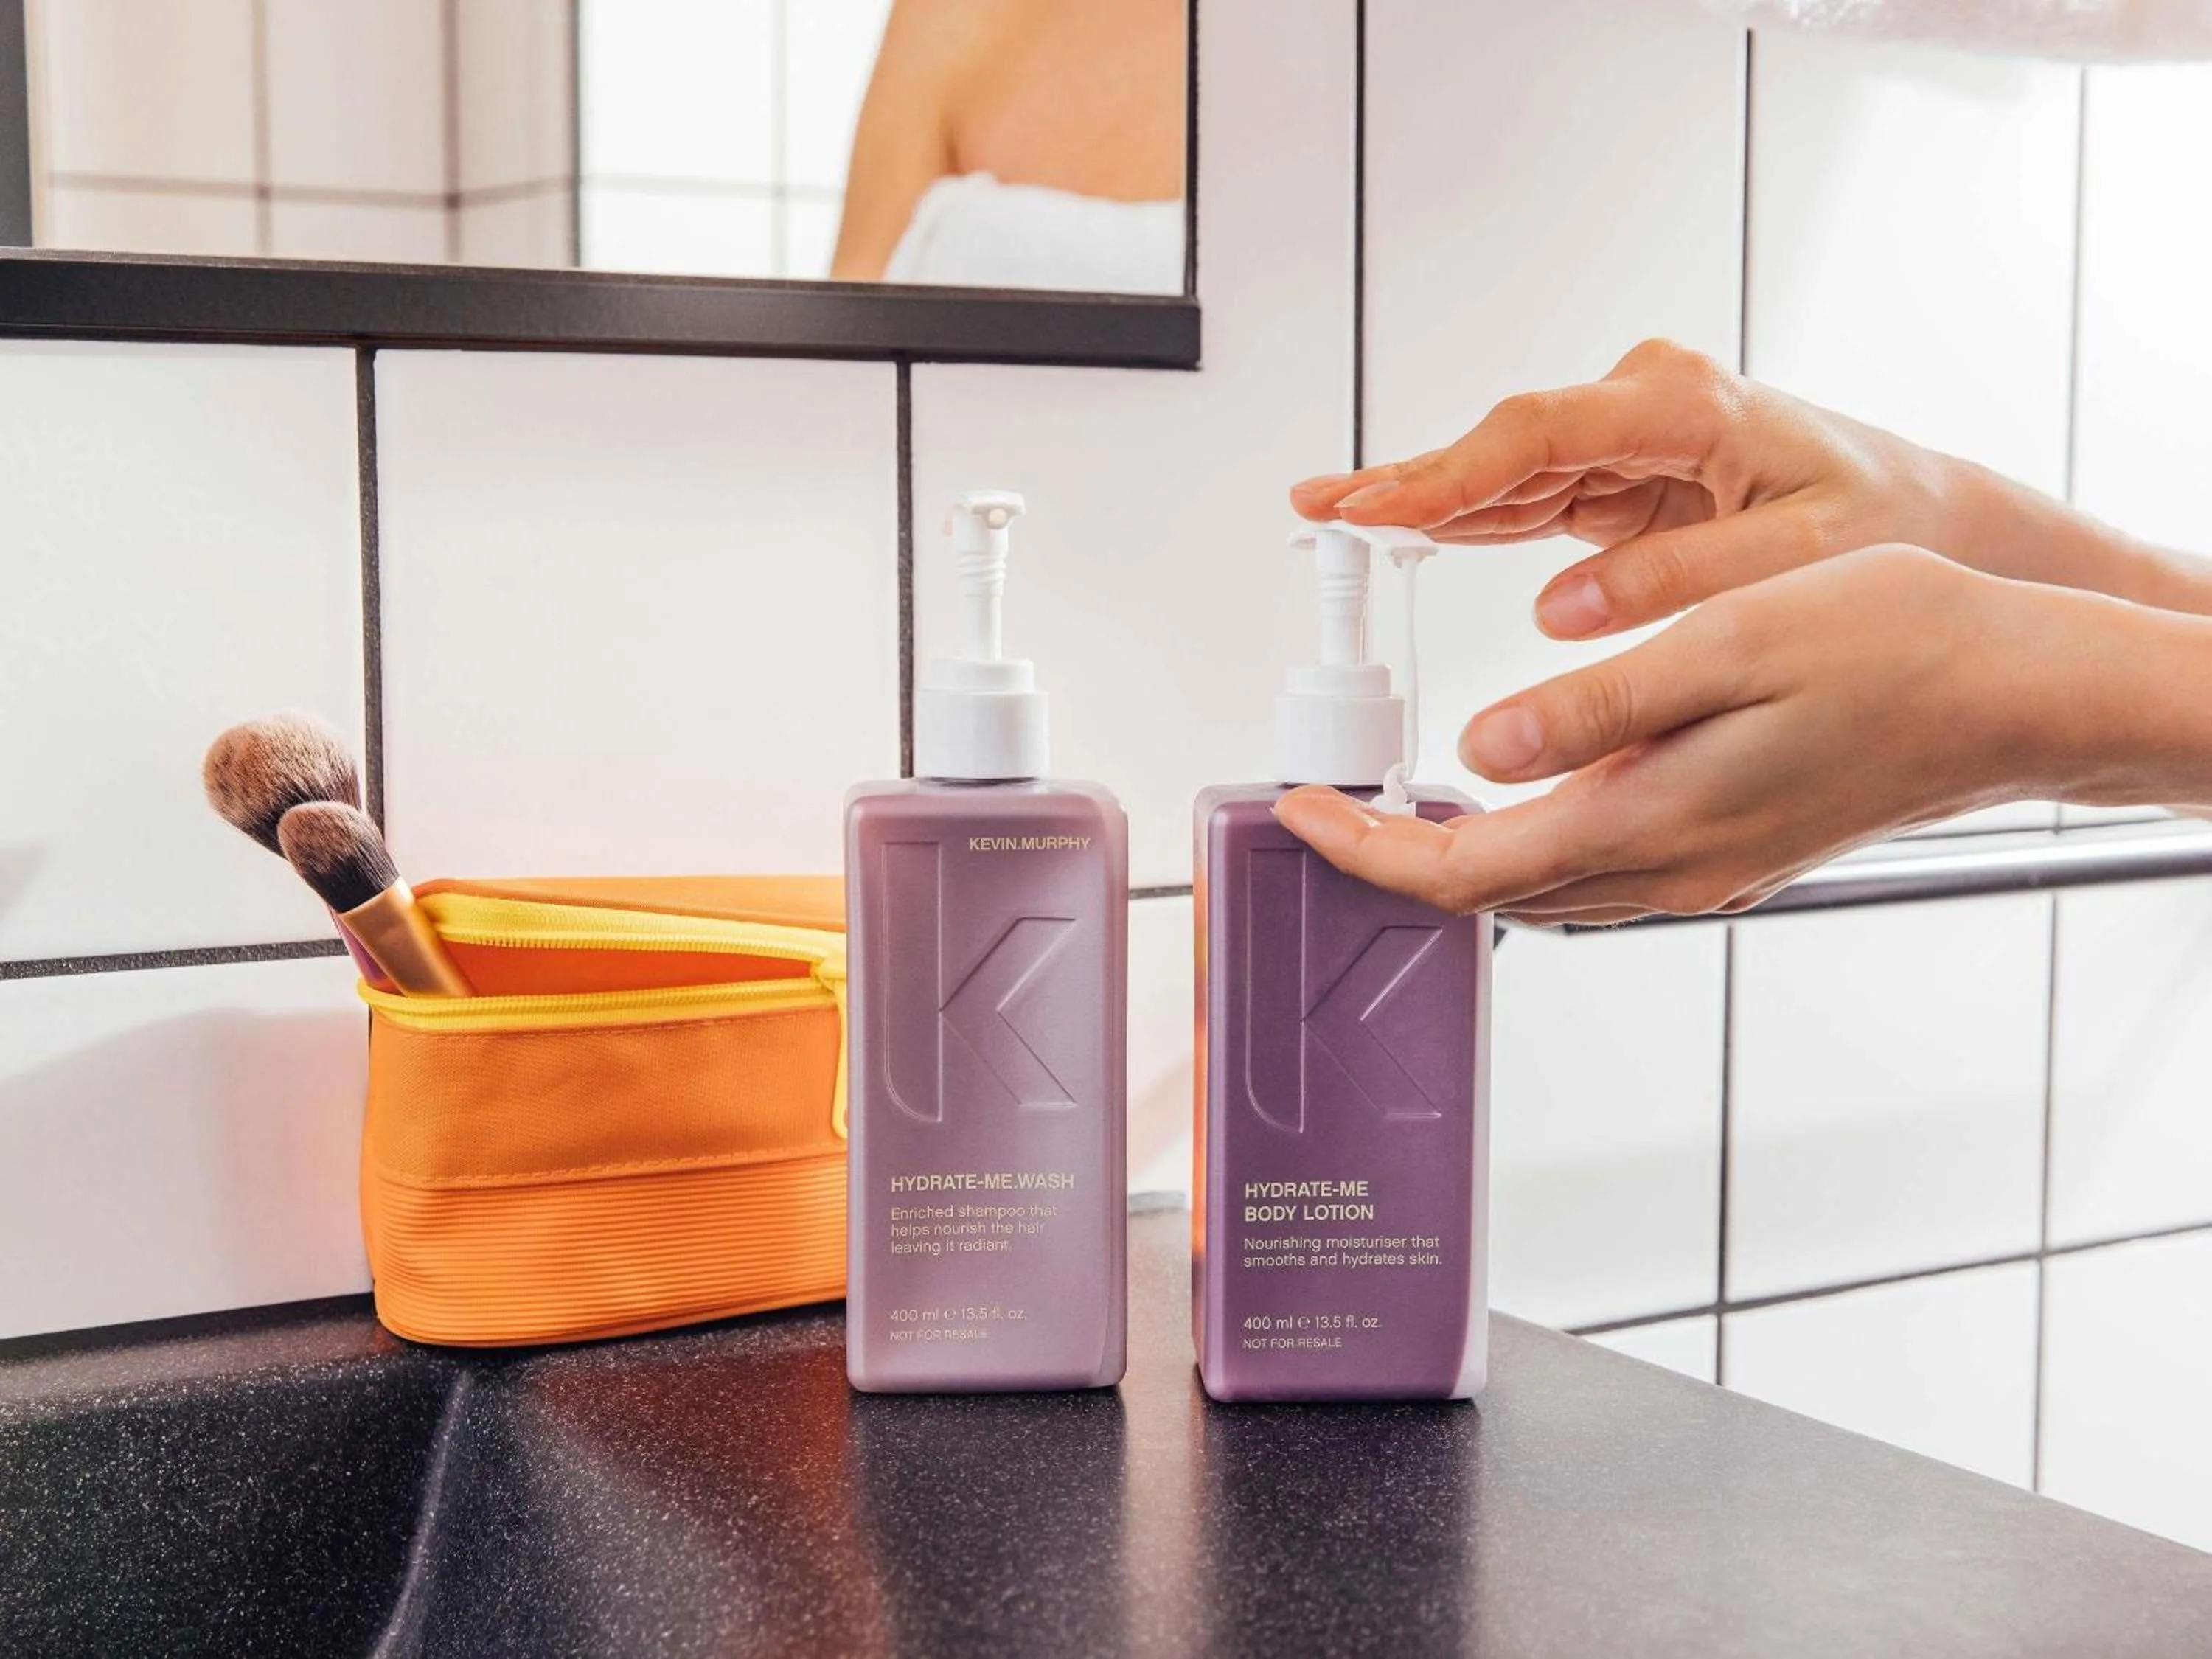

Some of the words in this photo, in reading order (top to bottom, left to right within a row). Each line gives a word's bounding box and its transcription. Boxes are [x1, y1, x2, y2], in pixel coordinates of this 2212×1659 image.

[969, 836, 1091, 851] KEVIN.MURPHY
[891, 1173, 1074, 1192] HYDRATE-ME.WASH
[1245, 1181, 1369, 1199] HYDRATE-ME
[891, 1205, 953, 1220] Enriched
[959, 1204, 1026, 1220] shampoo
[1029, 1204, 1057, 1217] that
[1245, 1206, 1297, 1222] BODY
[1304, 1204, 1374, 1220] LOTION
[891, 1224, 930, 1239] helps
[933, 1222, 986, 1236] nourish
[990, 1222, 1014, 1234] the
[1018, 1221, 1044, 1234] hair
[891, 1240, 941, 1256] leaving
[946, 1239, 955, 1251] it
[1244, 1236, 1321, 1252] Nourishing
[1326, 1234, 1408, 1248] moisturiser
[1411, 1235, 1440, 1248] that
[1244, 1253, 1305, 1267] smooths
[1310, 1253, 1338, 1266] and
[1342, 1252, 1405, 1268] hydrates
[1409, 1251, 1442, 1265] skin.
[890, 1309, 918, 1322] 400
[922, 1308, 939, 1321] ml
[961, 1307, 987, 1320] 13.5
[1244, 1316, 1270, 1329] 400
[1276, 1315, 1293, 1329] ml
[1315, 1315, 1341, 1329] 13.5
[1346, 1315, 1357, 1328] fl.
[889, 1330, 913, 1341] NOT
[917, 1329, 942, 1341] FOR
[1243, 1338, 1267, 1349] NOT
[1270, 1338, 1294, 1349] FOR
[1298, 1337, 1342, 1348] RESALE
